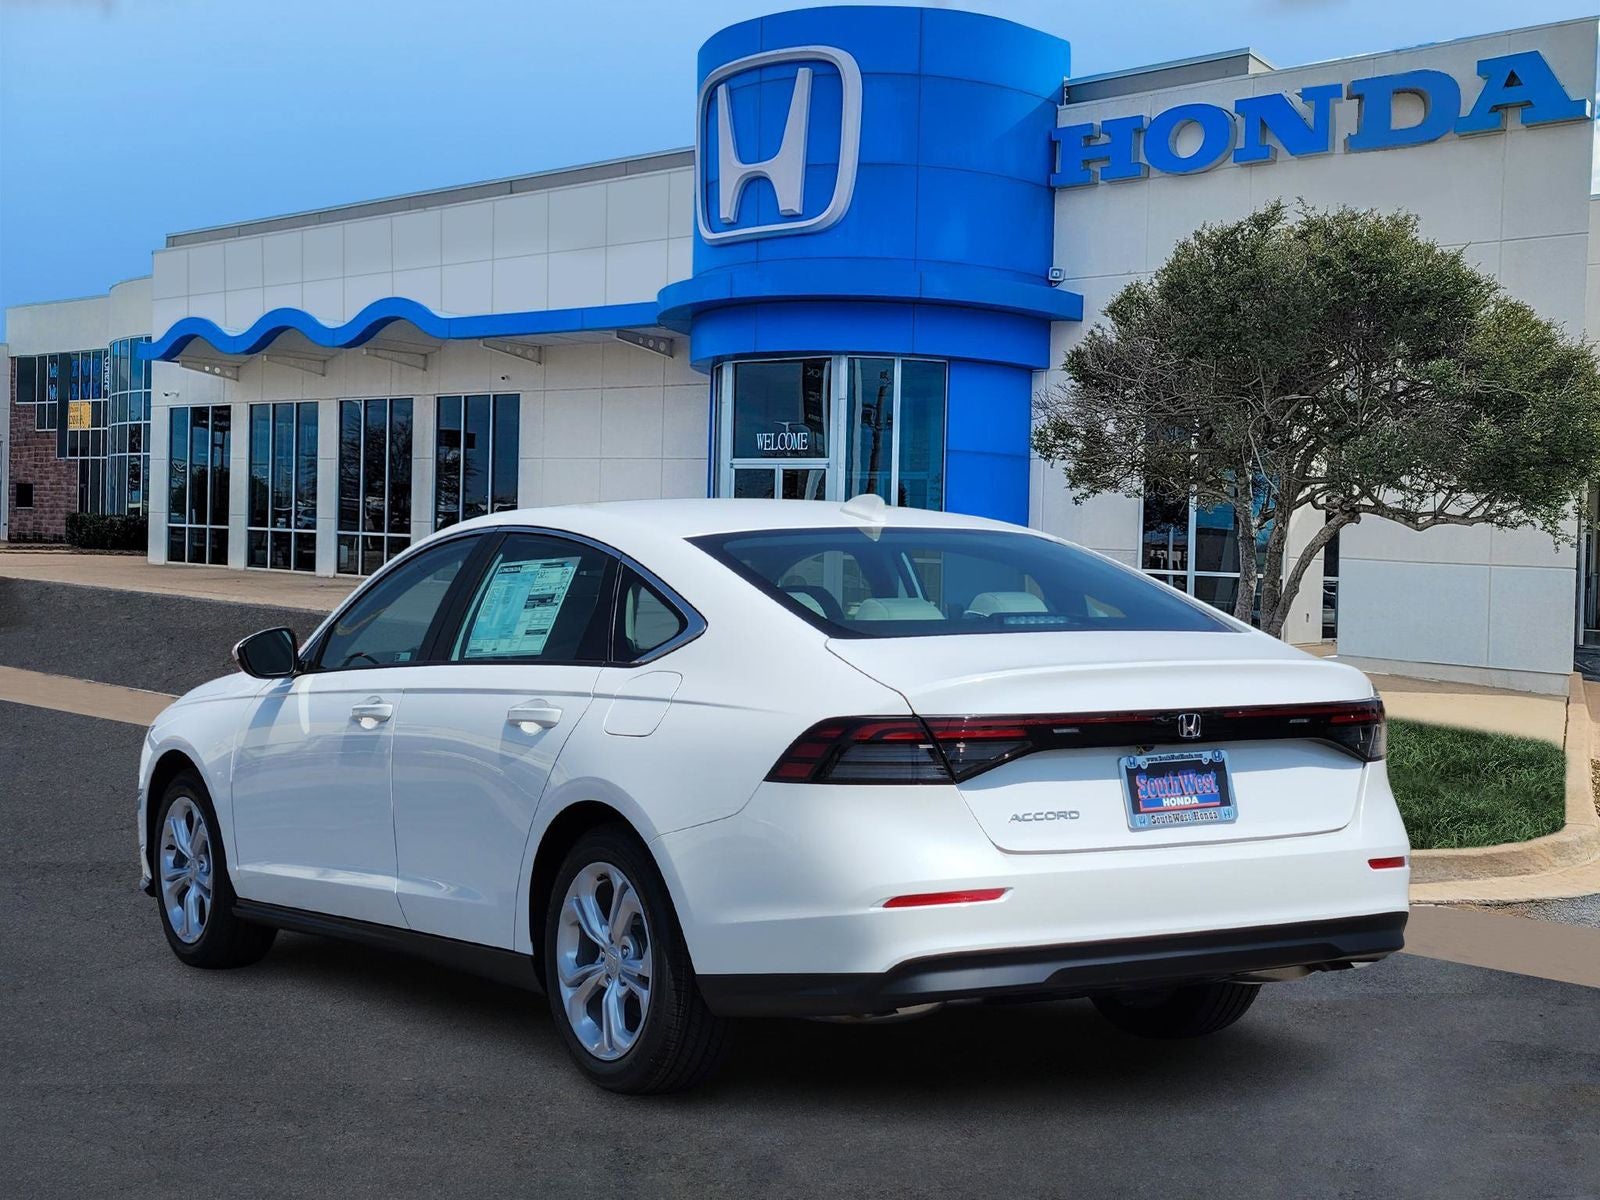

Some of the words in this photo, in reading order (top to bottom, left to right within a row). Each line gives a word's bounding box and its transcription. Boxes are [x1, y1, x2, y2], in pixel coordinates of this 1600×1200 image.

[1051, 50, 1591, 188] HONDA
[757, 432, 808, 450] WELCOME
[1136, 769, 1219, 799] SouthWest
[1162, 796, 1199, 807] HONDA
[1008, 810, 1080, 823] ACCORD
[1151, 813, 1192, 825] SouthWest
[1193, 810, 1218, 821] Honda
